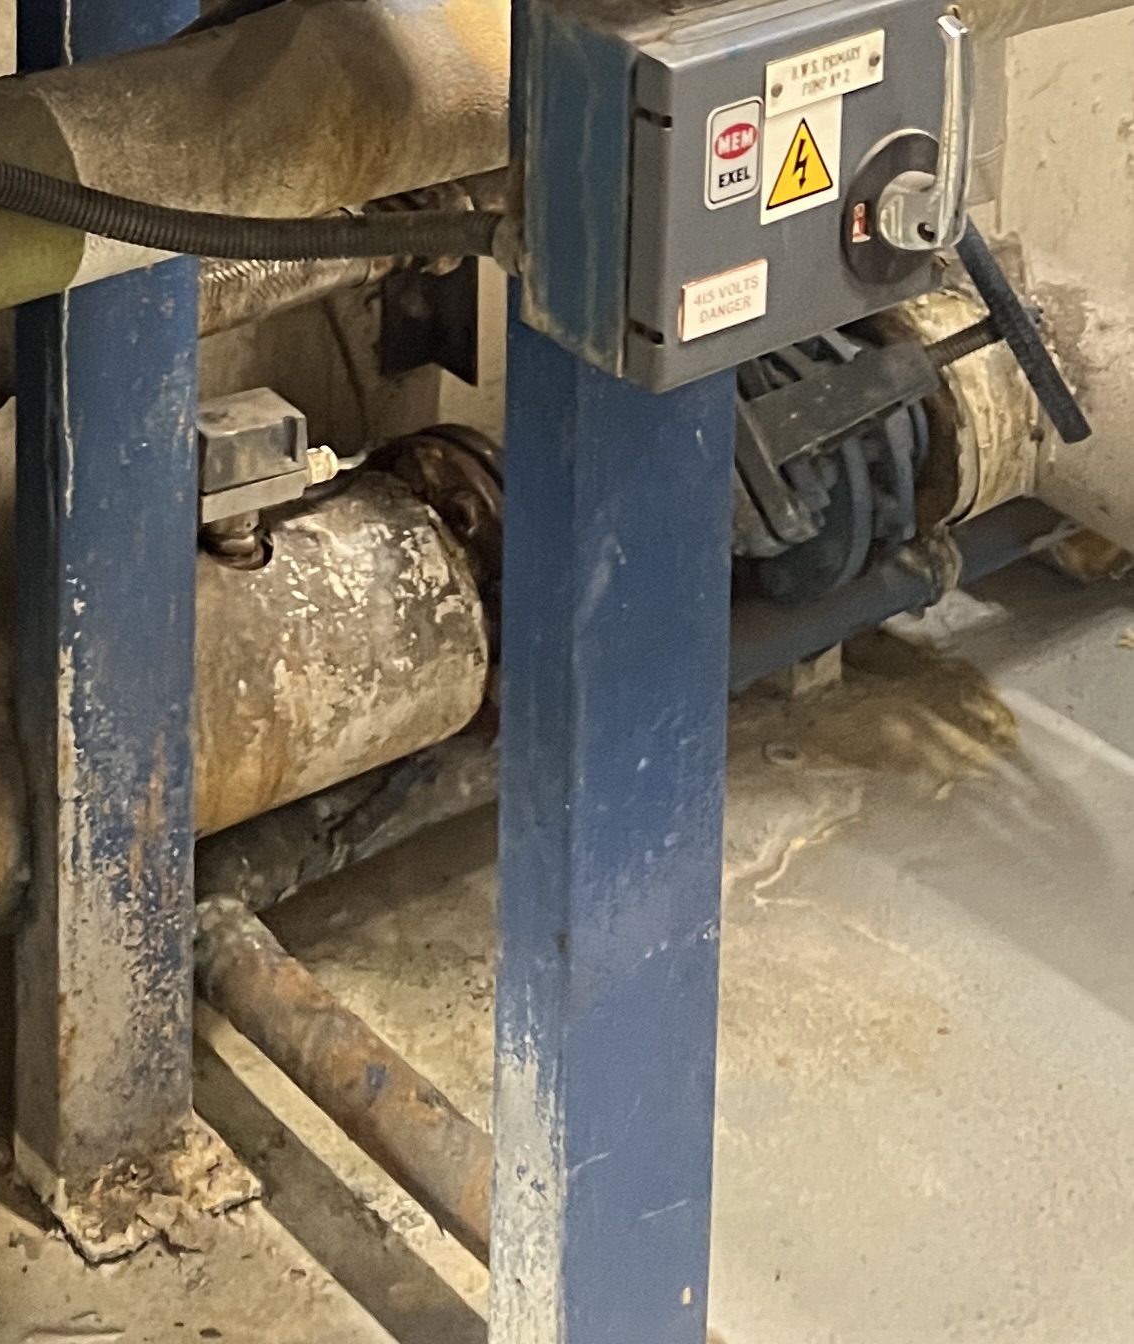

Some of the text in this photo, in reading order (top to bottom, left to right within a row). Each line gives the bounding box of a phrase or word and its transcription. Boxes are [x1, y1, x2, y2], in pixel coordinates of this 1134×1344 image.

[802, 76, 827, 97] PUMP
[716, 127, 755, 154] MEM
[718, 166, 752, 188] EXEL
[693, 275, 759, 307] 415 VOLTS
[699, 295, 751, 324] DANGER
